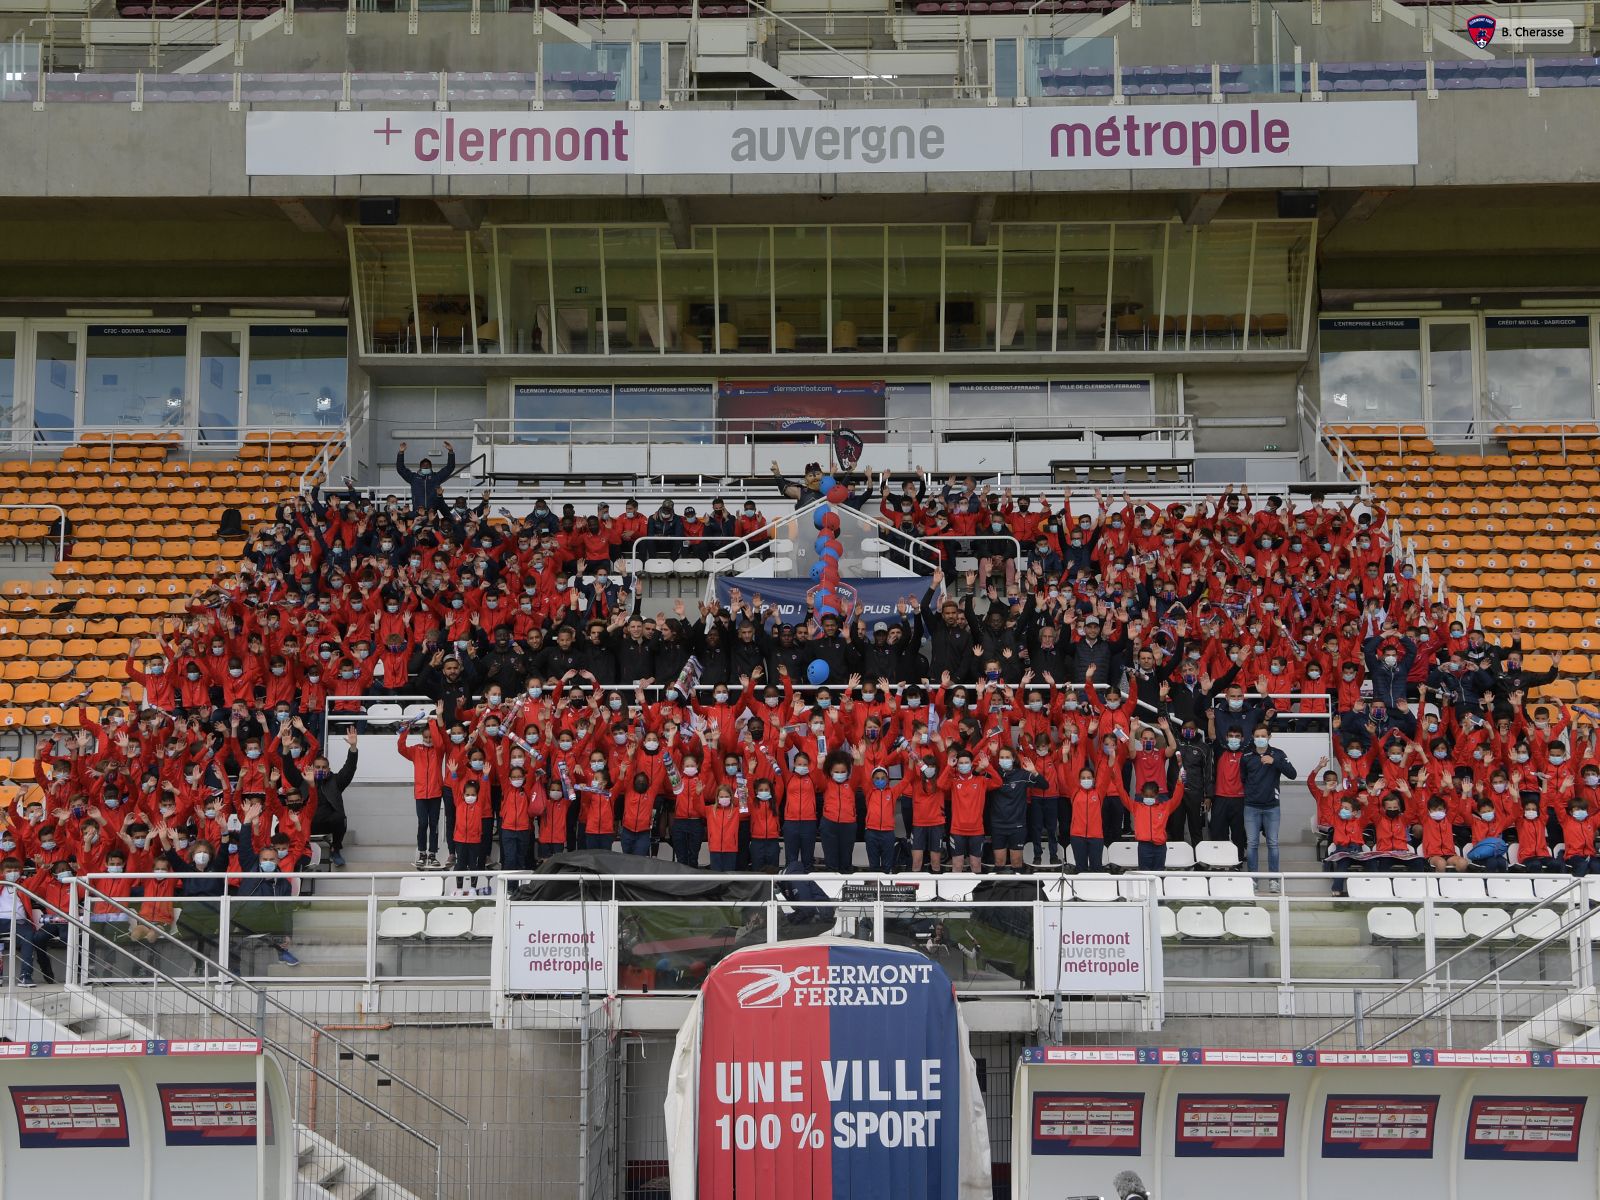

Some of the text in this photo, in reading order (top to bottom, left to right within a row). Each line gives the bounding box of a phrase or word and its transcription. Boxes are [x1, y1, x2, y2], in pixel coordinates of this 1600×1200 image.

[413, 109, 1290, 166] clermont auvergne métropole
[773, 385, 833, 393] clermontfoot.com
[838, 587, 853, 597] FOOT
[863, 605, 891, 614] PLUS
[528, 930, 595, 944] clermont
[1062, 931, 1130, 945] clermont
[523, 946, 590, 958] auvergne
[1060, 947, 1126, 959] auvergne
[529, 957, 603, 974] métropole
[1064, 959, 1140, 976] métropole
[792, 964, 933, 986] CLERMONT
[793, 986, 908, 1007] FERRAND
[715, 1059, 941, 1104] UNE VILLE
[715, 1110, 941, 1150] 100 % SPORT
